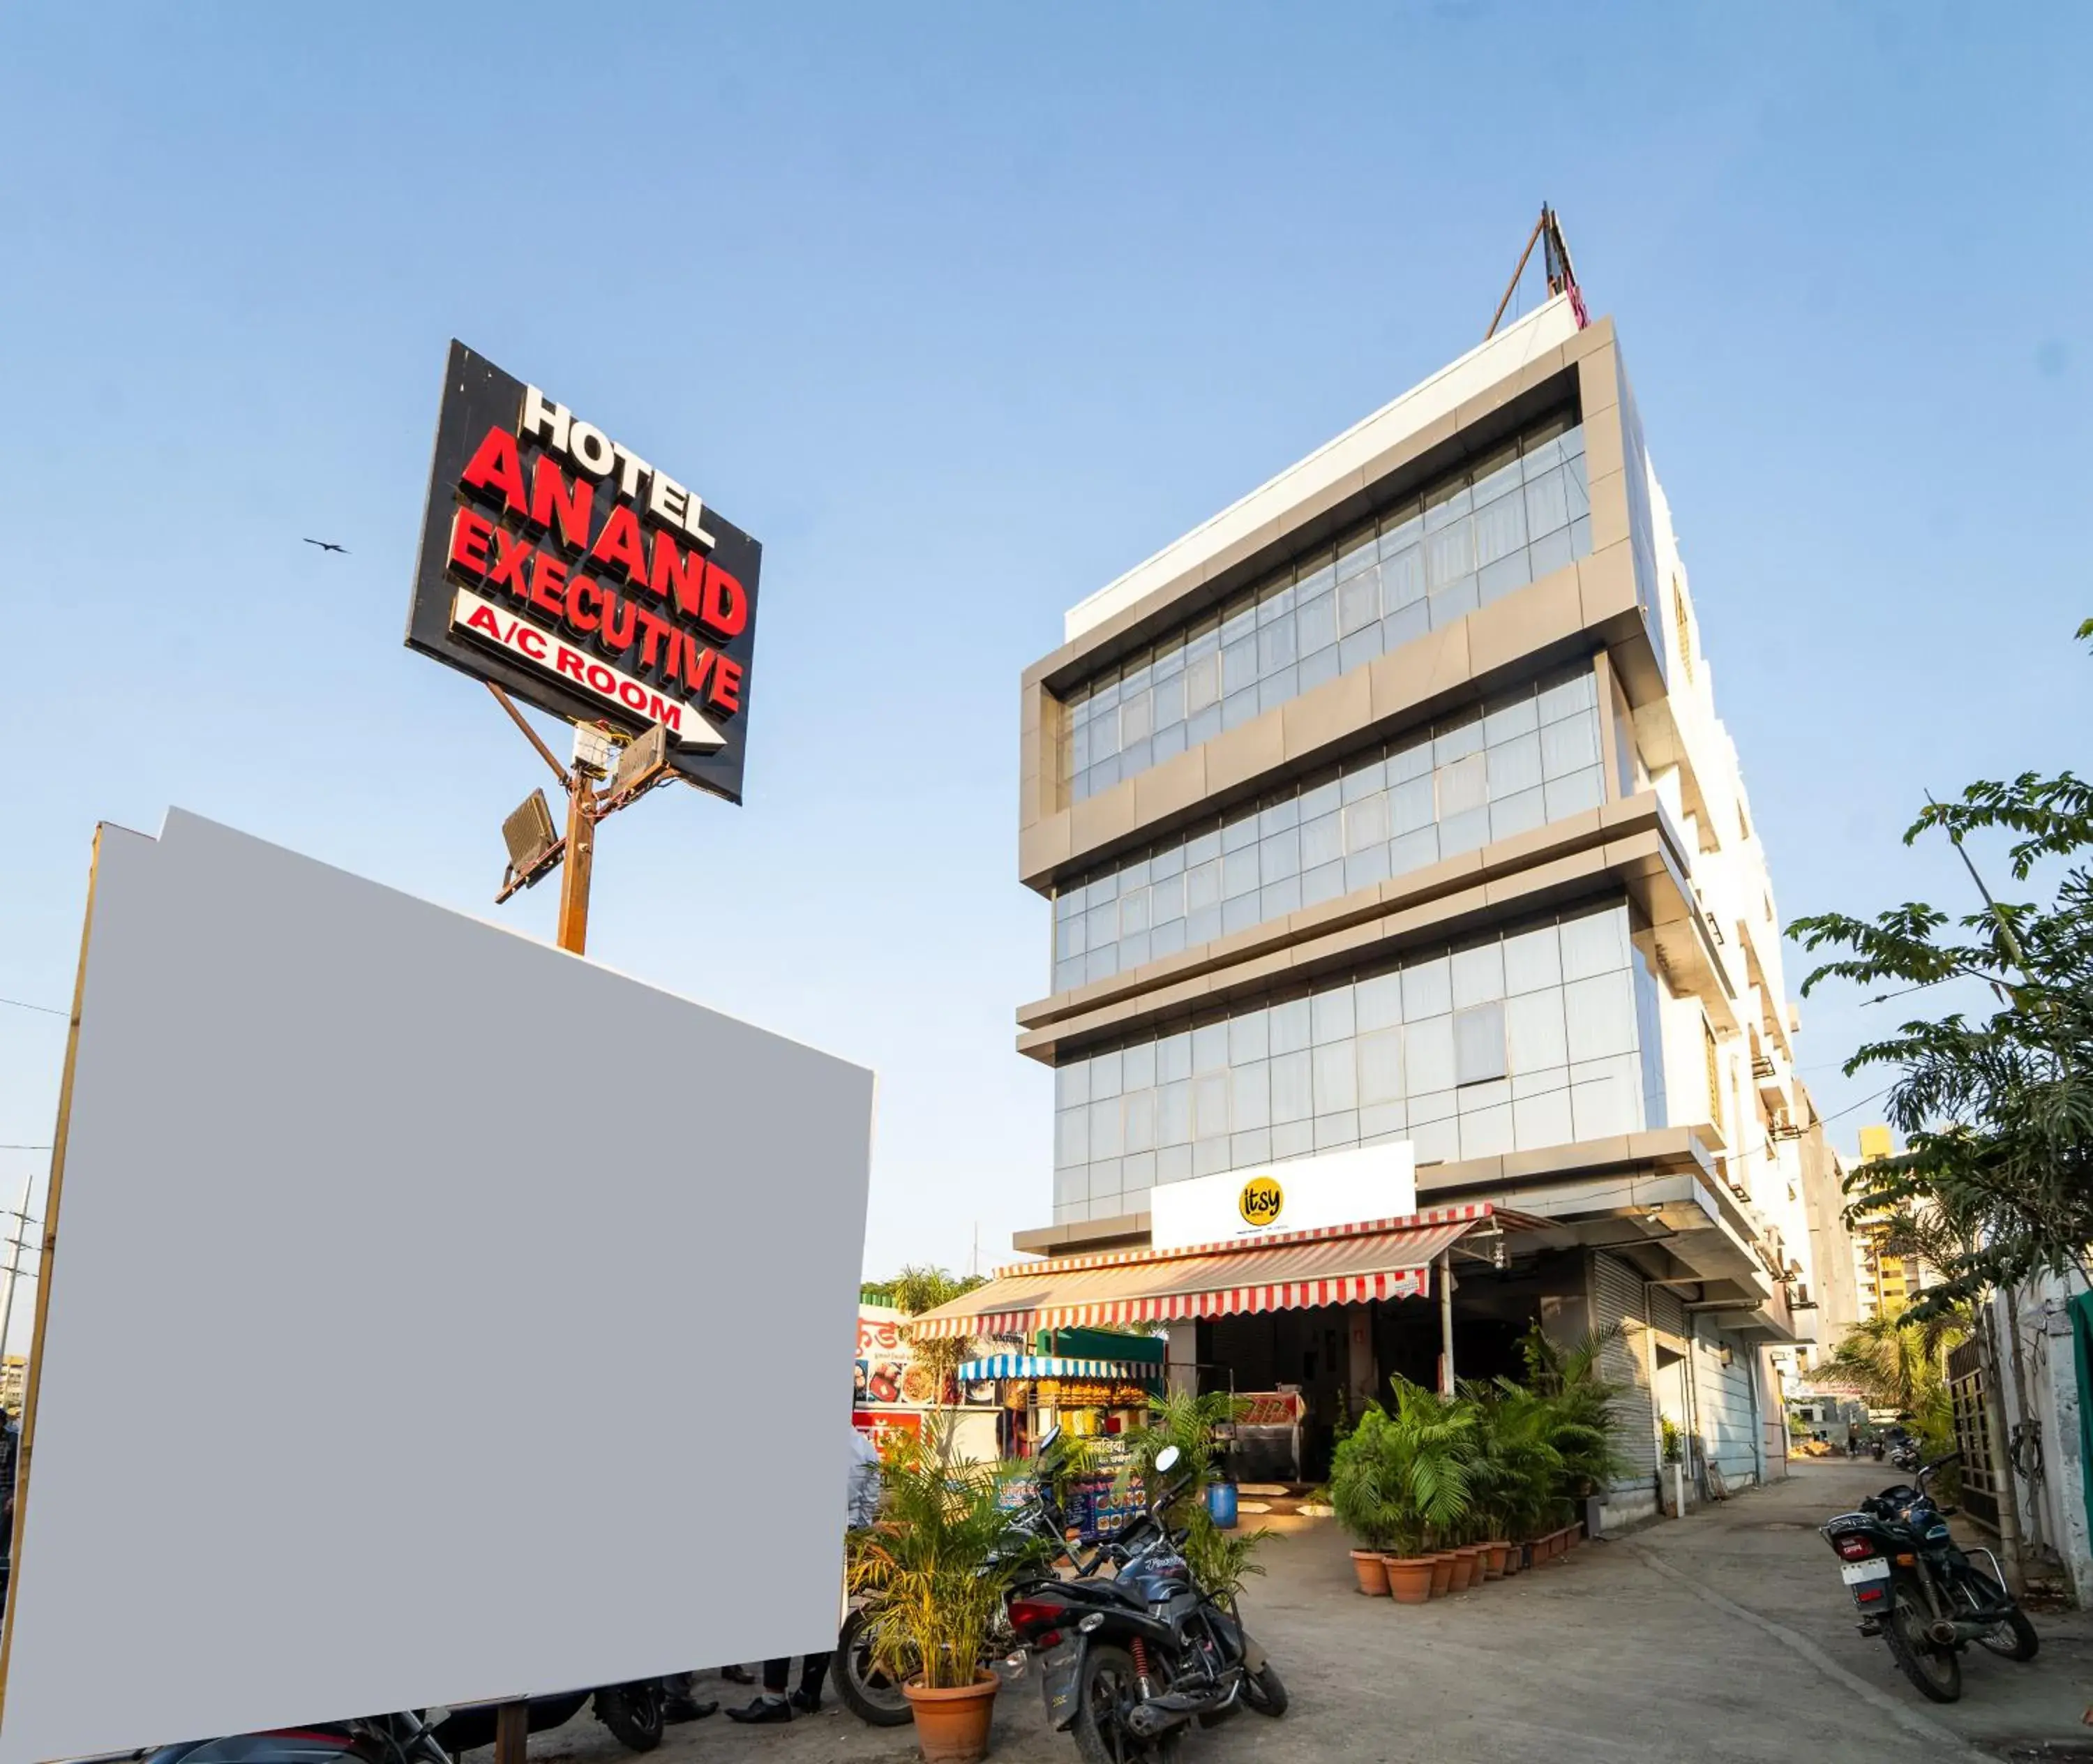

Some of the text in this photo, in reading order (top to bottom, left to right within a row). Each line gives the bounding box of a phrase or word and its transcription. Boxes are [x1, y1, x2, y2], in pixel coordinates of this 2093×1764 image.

[462, 426, 748, 636] ANAND
[523, 384, 717, 549] HOTEL
[450, 507, 743, 711] EXECUTIVE
[467, 604, 682, 731] A/C ROOM
[1245, 1188, 1280, 1216] itsy
